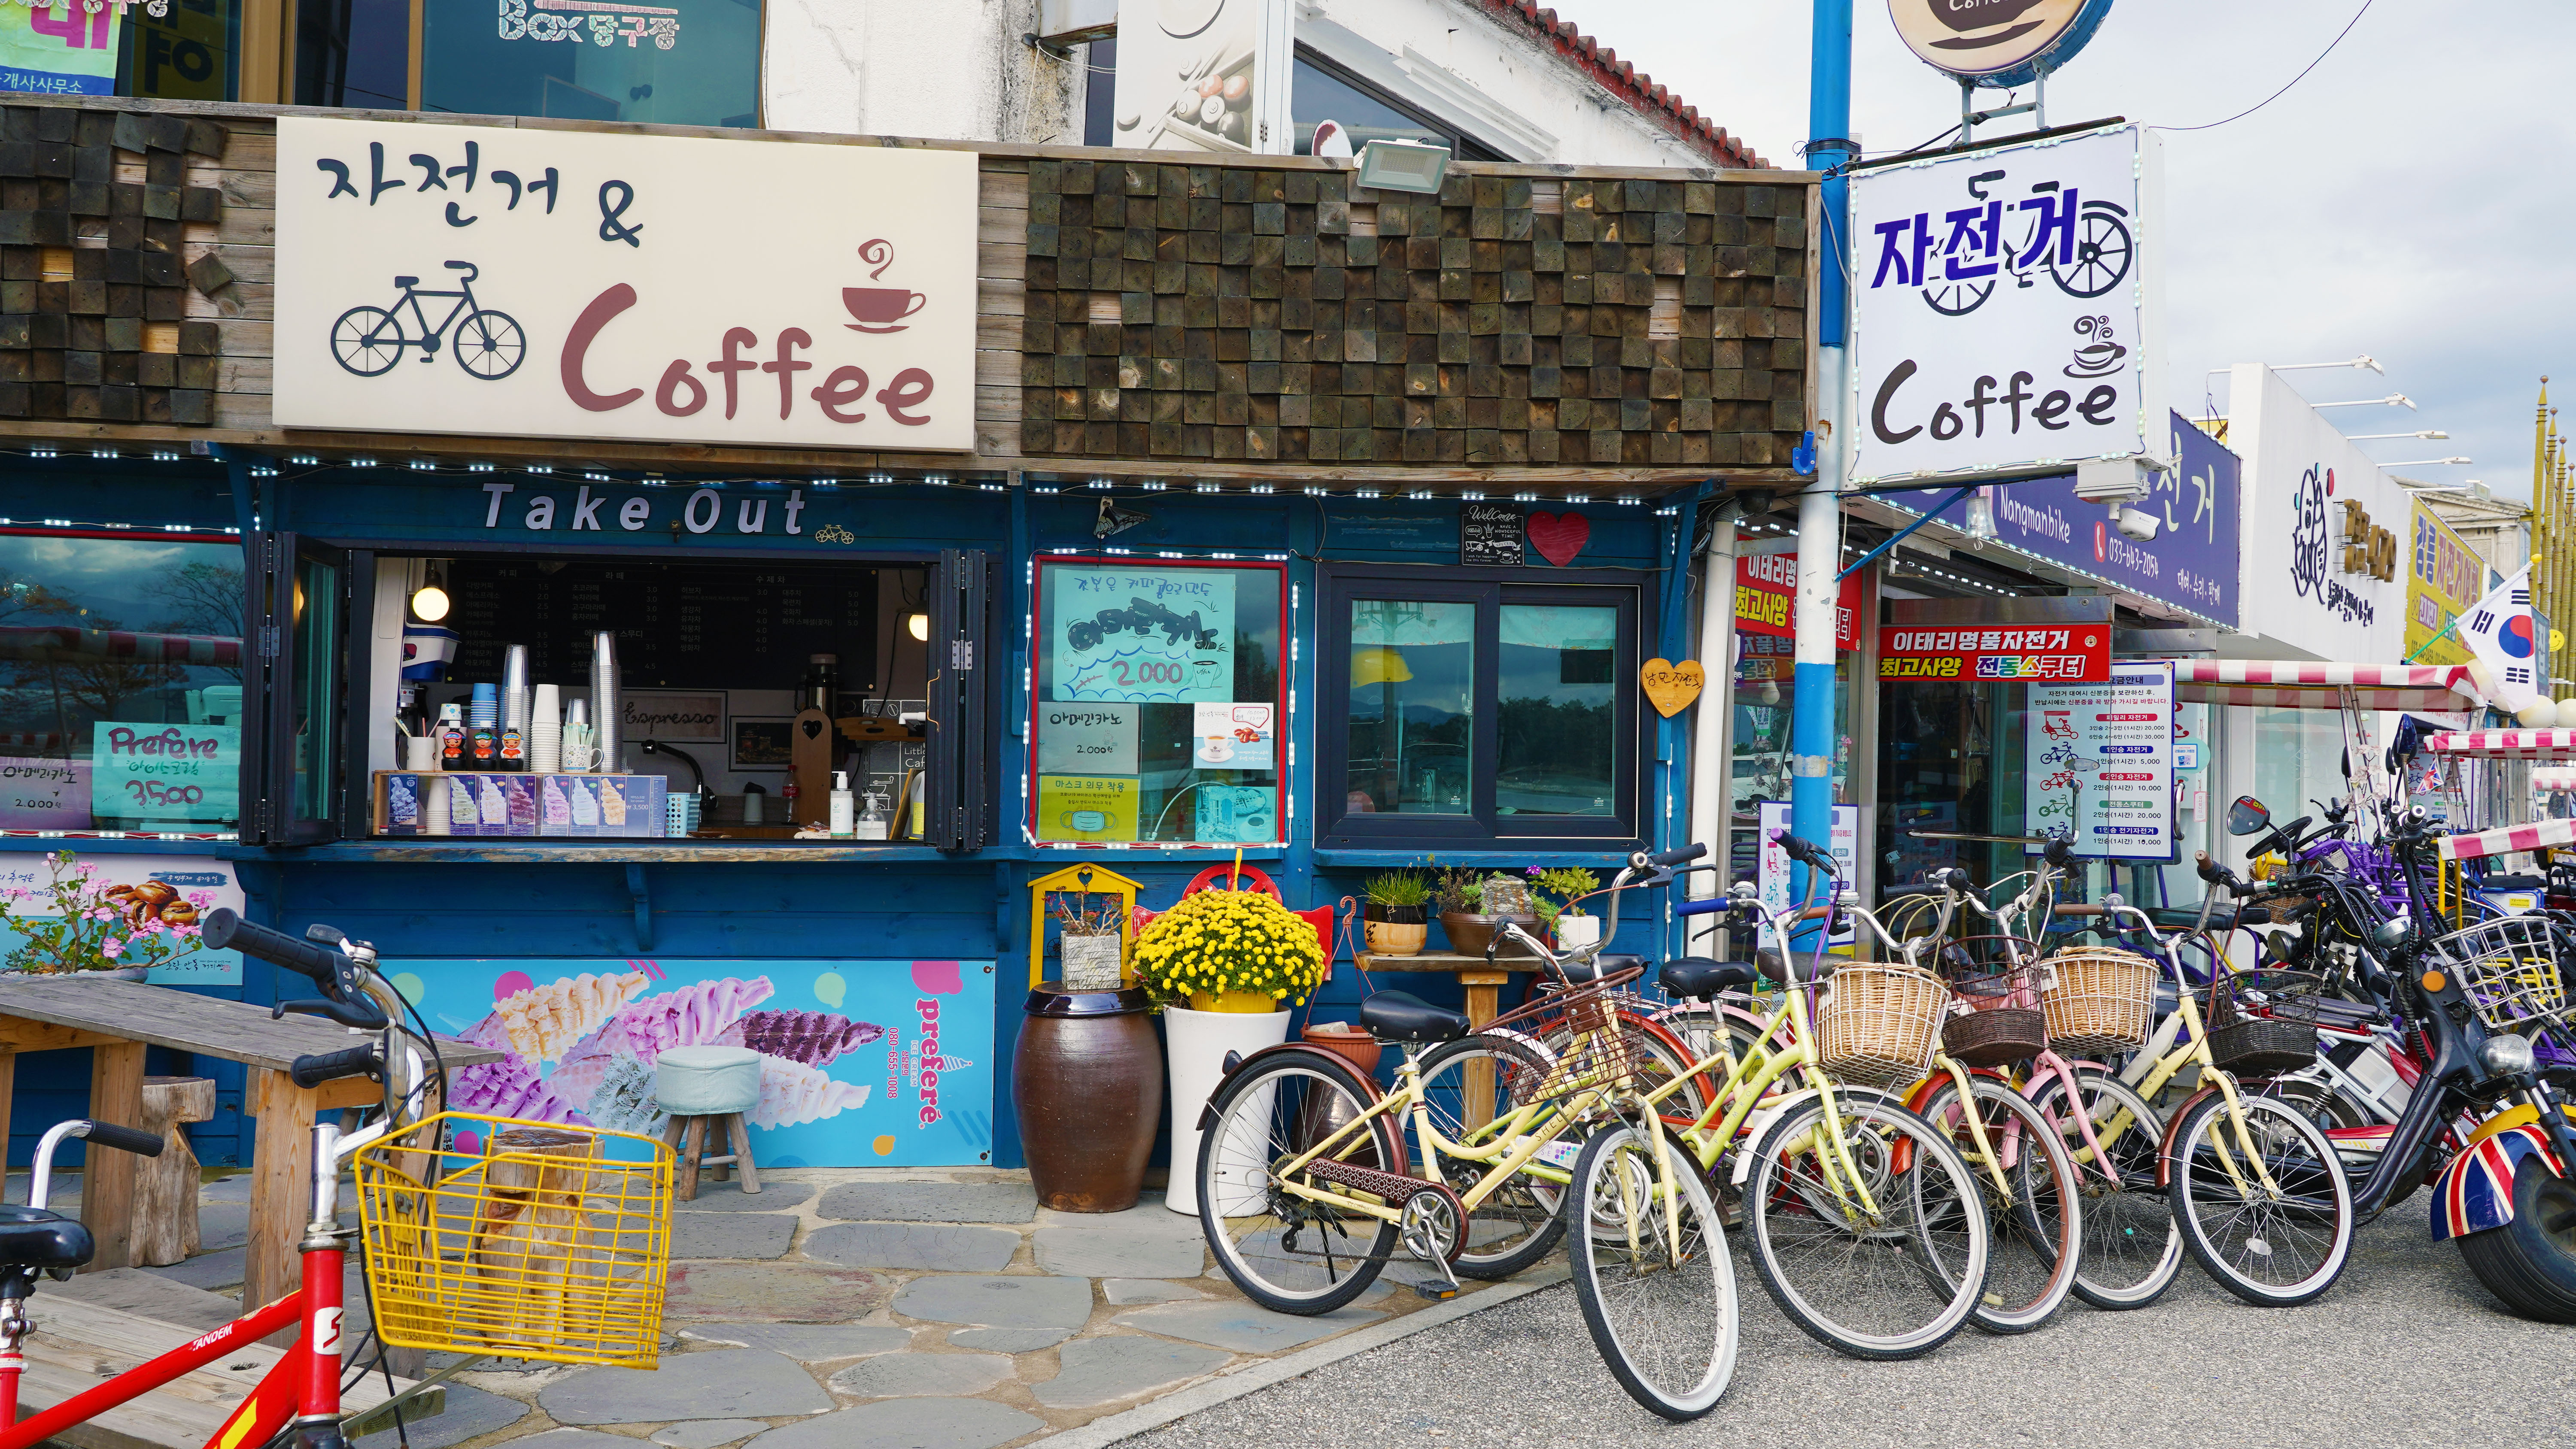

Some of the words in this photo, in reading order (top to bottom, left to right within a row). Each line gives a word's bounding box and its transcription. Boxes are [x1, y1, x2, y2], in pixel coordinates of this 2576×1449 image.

[0, 71, 83, 94] 개사사무소
[316, 140, 558, 227] 자전거
[598, 180, 644, 247] &
[1871, 188, 2078, 288] 자전거
[560, 282, 935, 425] Coffee
[1871, 359, 2117, 444] Coffee
[482, 483, 650, 531] Take
[684, 489, 805, 535] Out
[2001, 485, 2070, 544] Nangmanbike
[2109, 537, 2159, 579] 033-643-2054
[1735, 584, 1789, 628] 최고사양
[620, 630, 643, 638] 스무디
[1894, 631, 2069, 651] 이태리명품자전거
[1880, 656, 1964, 677] 최고사양
[1975, 655, 2087, 679] 전동스쿠터
[623, 702, 718, 734] Espresso
[1050, 712, 1122, 726] 아메리카노
[3, 766, 77, 784] 아메리카노
[1056, 780, 1082, 788] 마스크
[1086, 781, 1103, 791] 의무
[1107, 782, 1125, 793] 착용
[7, 869, 36, 885] 추억은
[887, 1027, 899, 1099] 080-655-1008
[901, 1050, 909, 1076] 상담문의
[1535, 1102, 1574, 1141] SHELLY
